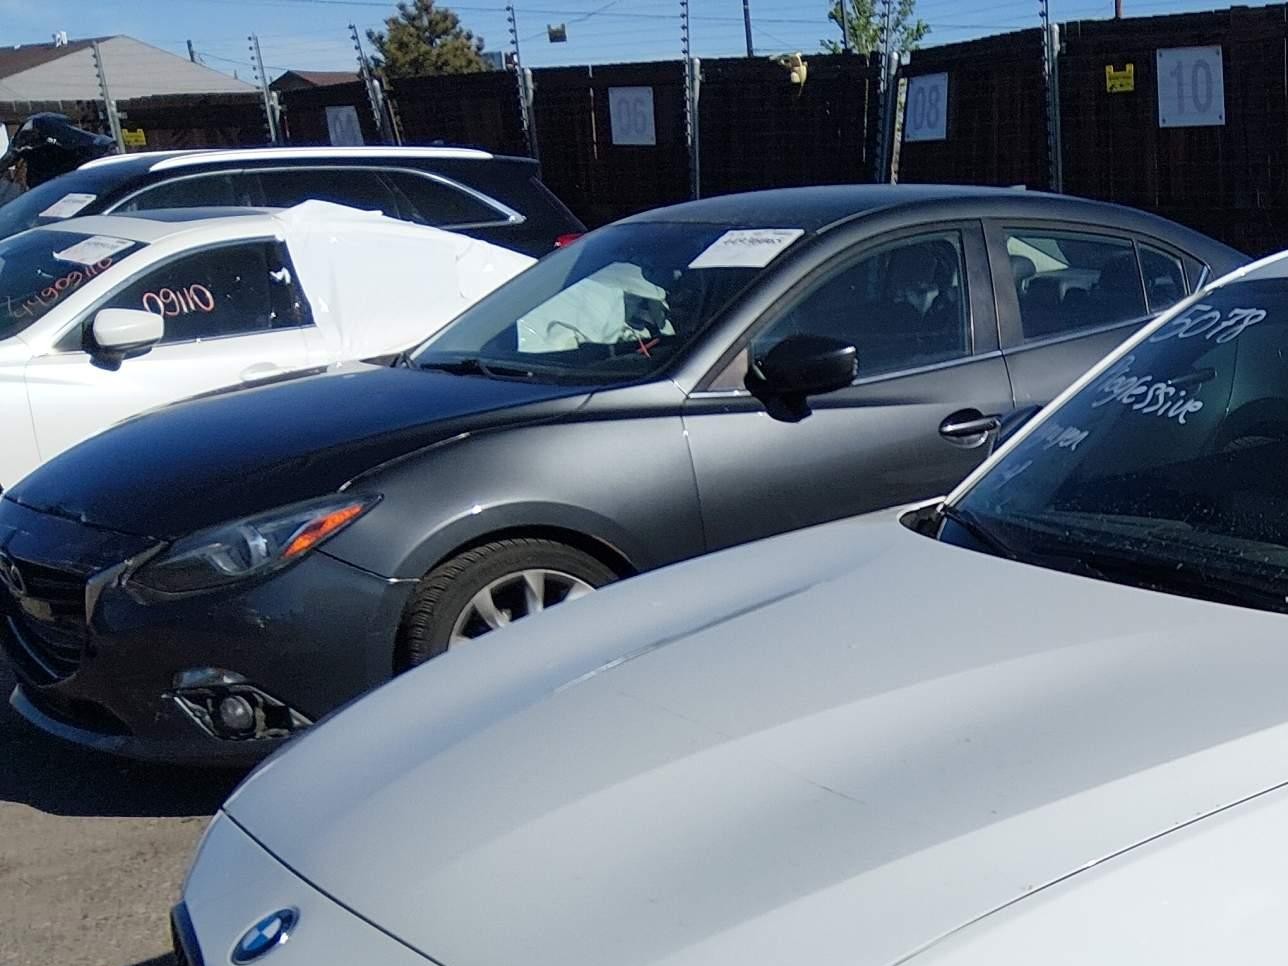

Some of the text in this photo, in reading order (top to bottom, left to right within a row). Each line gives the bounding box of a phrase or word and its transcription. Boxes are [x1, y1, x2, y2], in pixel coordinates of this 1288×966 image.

[1170, 58, 1213, 114] 10
[617, 97, 647, 135] 06
[912, 86, 940, 130] 08
[143, 284, 215, 317] 09110
[1150, 303, 1267, 344] 5078
